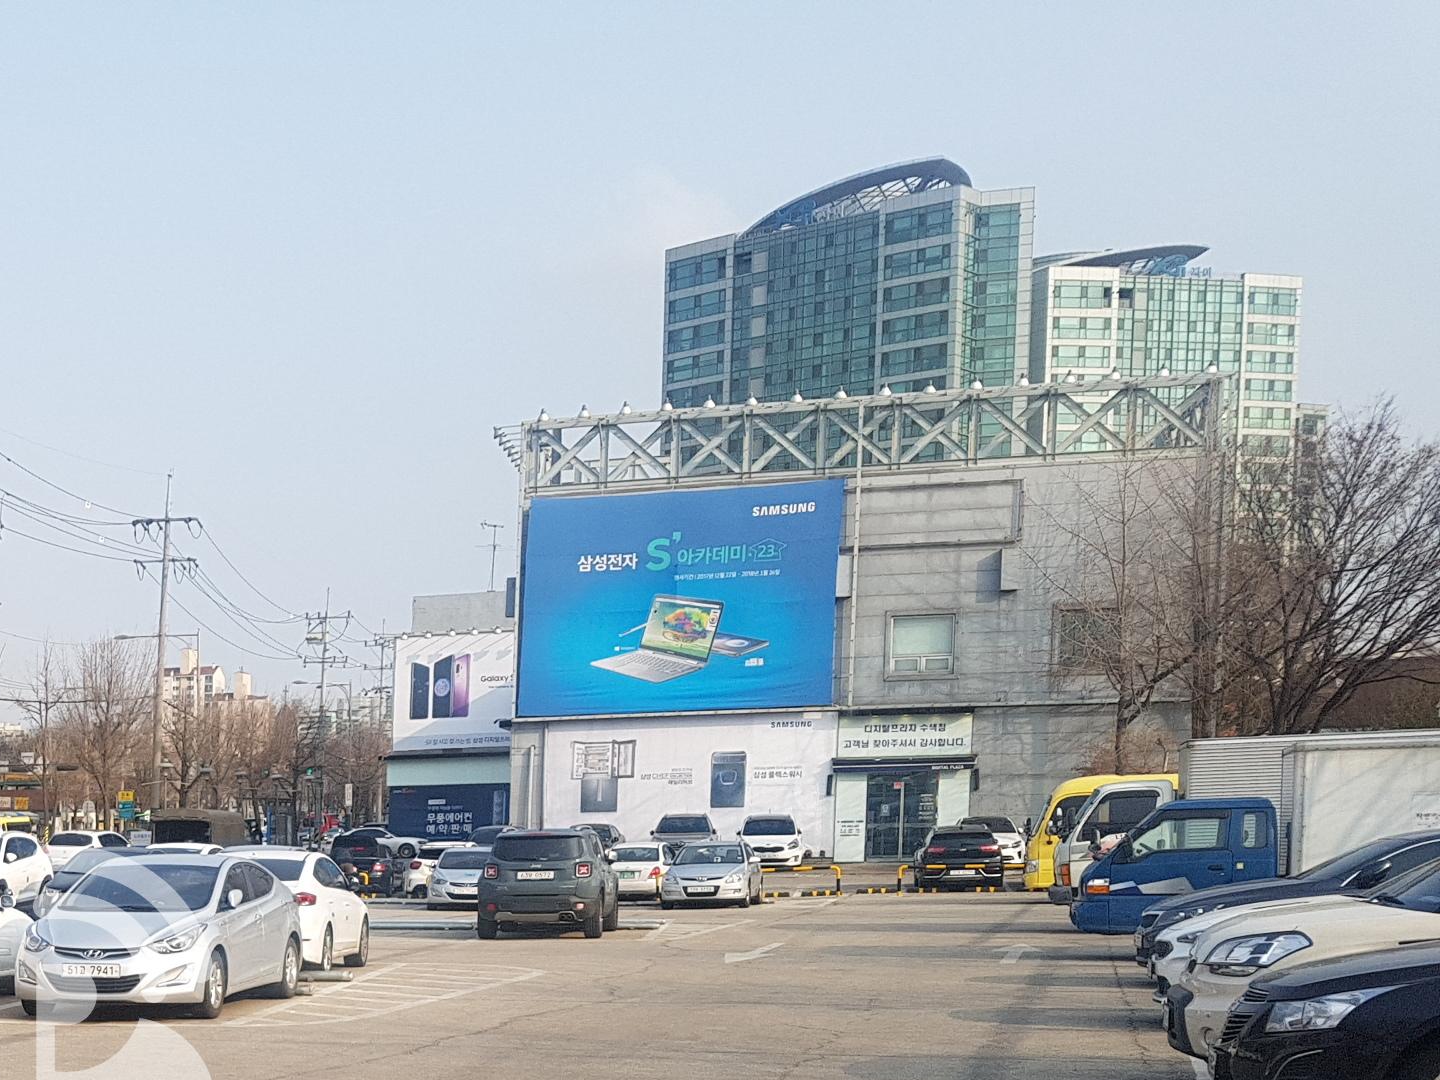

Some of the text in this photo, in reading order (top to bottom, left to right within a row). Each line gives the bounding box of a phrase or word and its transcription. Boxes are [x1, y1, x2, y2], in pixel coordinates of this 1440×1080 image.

[752, 501, 817, 517] SAMSUNG
[577, 552, 638, 573] 삼성전자
[677, 544, 747, 566] 아카데미
[480, 674, 509, 684] Galaxy
[770, 720, 812, 729] SAMSUNG
[864, 724, 917, 733] 디지털프라자
[843, 740, 869, 749] 고객님
[427, 812, 472, 823] 무풍에어컨
[90, 965, 114, 976] 7941
